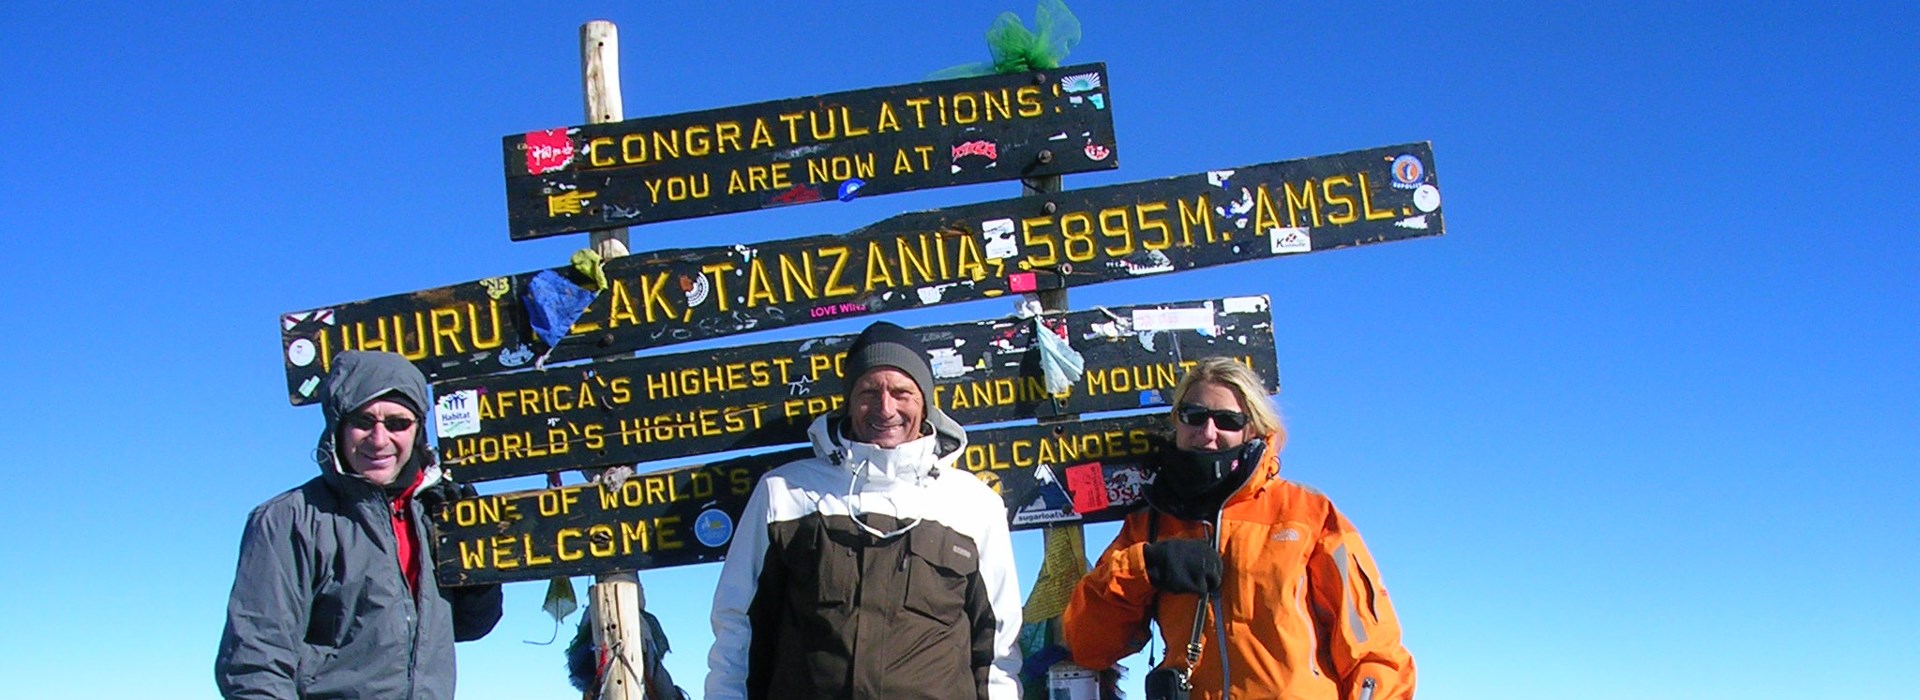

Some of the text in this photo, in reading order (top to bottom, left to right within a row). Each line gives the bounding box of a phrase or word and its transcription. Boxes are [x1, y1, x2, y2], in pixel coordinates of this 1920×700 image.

[589, 82, 1063, 167] CONGRATULATIONS!
[644, 172, 711, 204] YOU
[727, 162, 793, 195] ARE
[807, 152, 876, 185] NOW
[893, 146, 935, 176] AT
[1254, 171, 1413, 237] AMSL.
[810, 304, 837, 318] LOVE
[646, 357, 794, 400] HIGHEST
[441, 411, 470, 422] Habitat
[620, 402, 768, 446] HIGHEST
[455, 495, 523, 527] ONE
[538, 487, 583, 517] OF
[951, 429, 1159, 472] OLCANOES.
[459, 516, 684, 570] WELCOME
